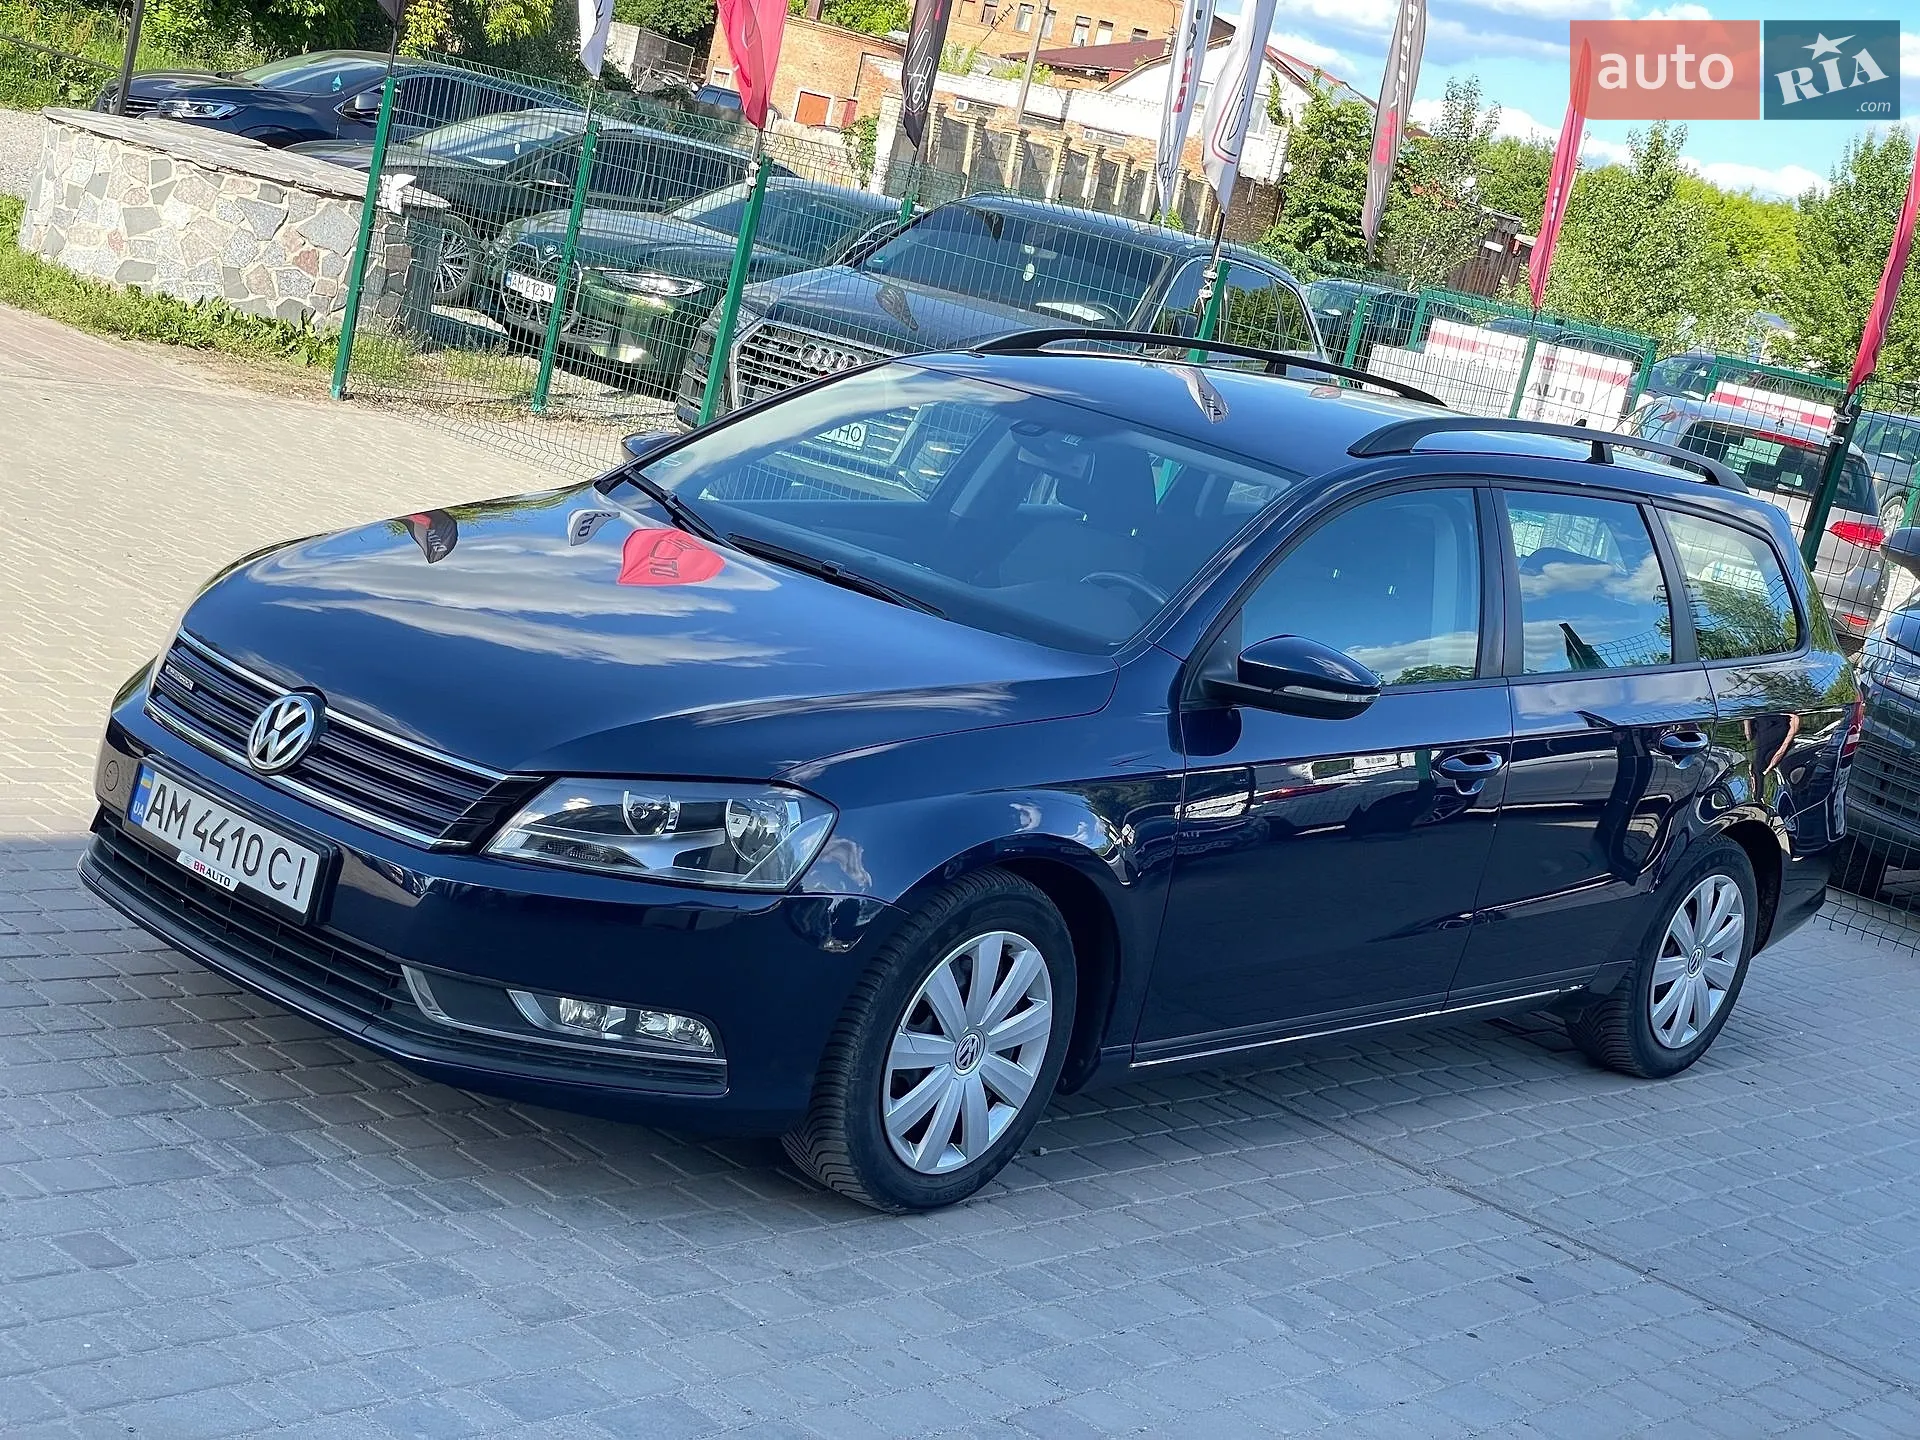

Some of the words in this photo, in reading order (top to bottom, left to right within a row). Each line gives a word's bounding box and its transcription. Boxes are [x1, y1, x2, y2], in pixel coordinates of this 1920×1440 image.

[525, 280, 545, 299] 2125
[1527, 382, 1585, 404] AUTO
[133, 801, 144, 817] UA
[146, 783, 192, 840] AM
[192, 807, 264, 877] 4410
[268, 847, 307, 901] CI
[193, 860, 231, 888] BRAUTO
